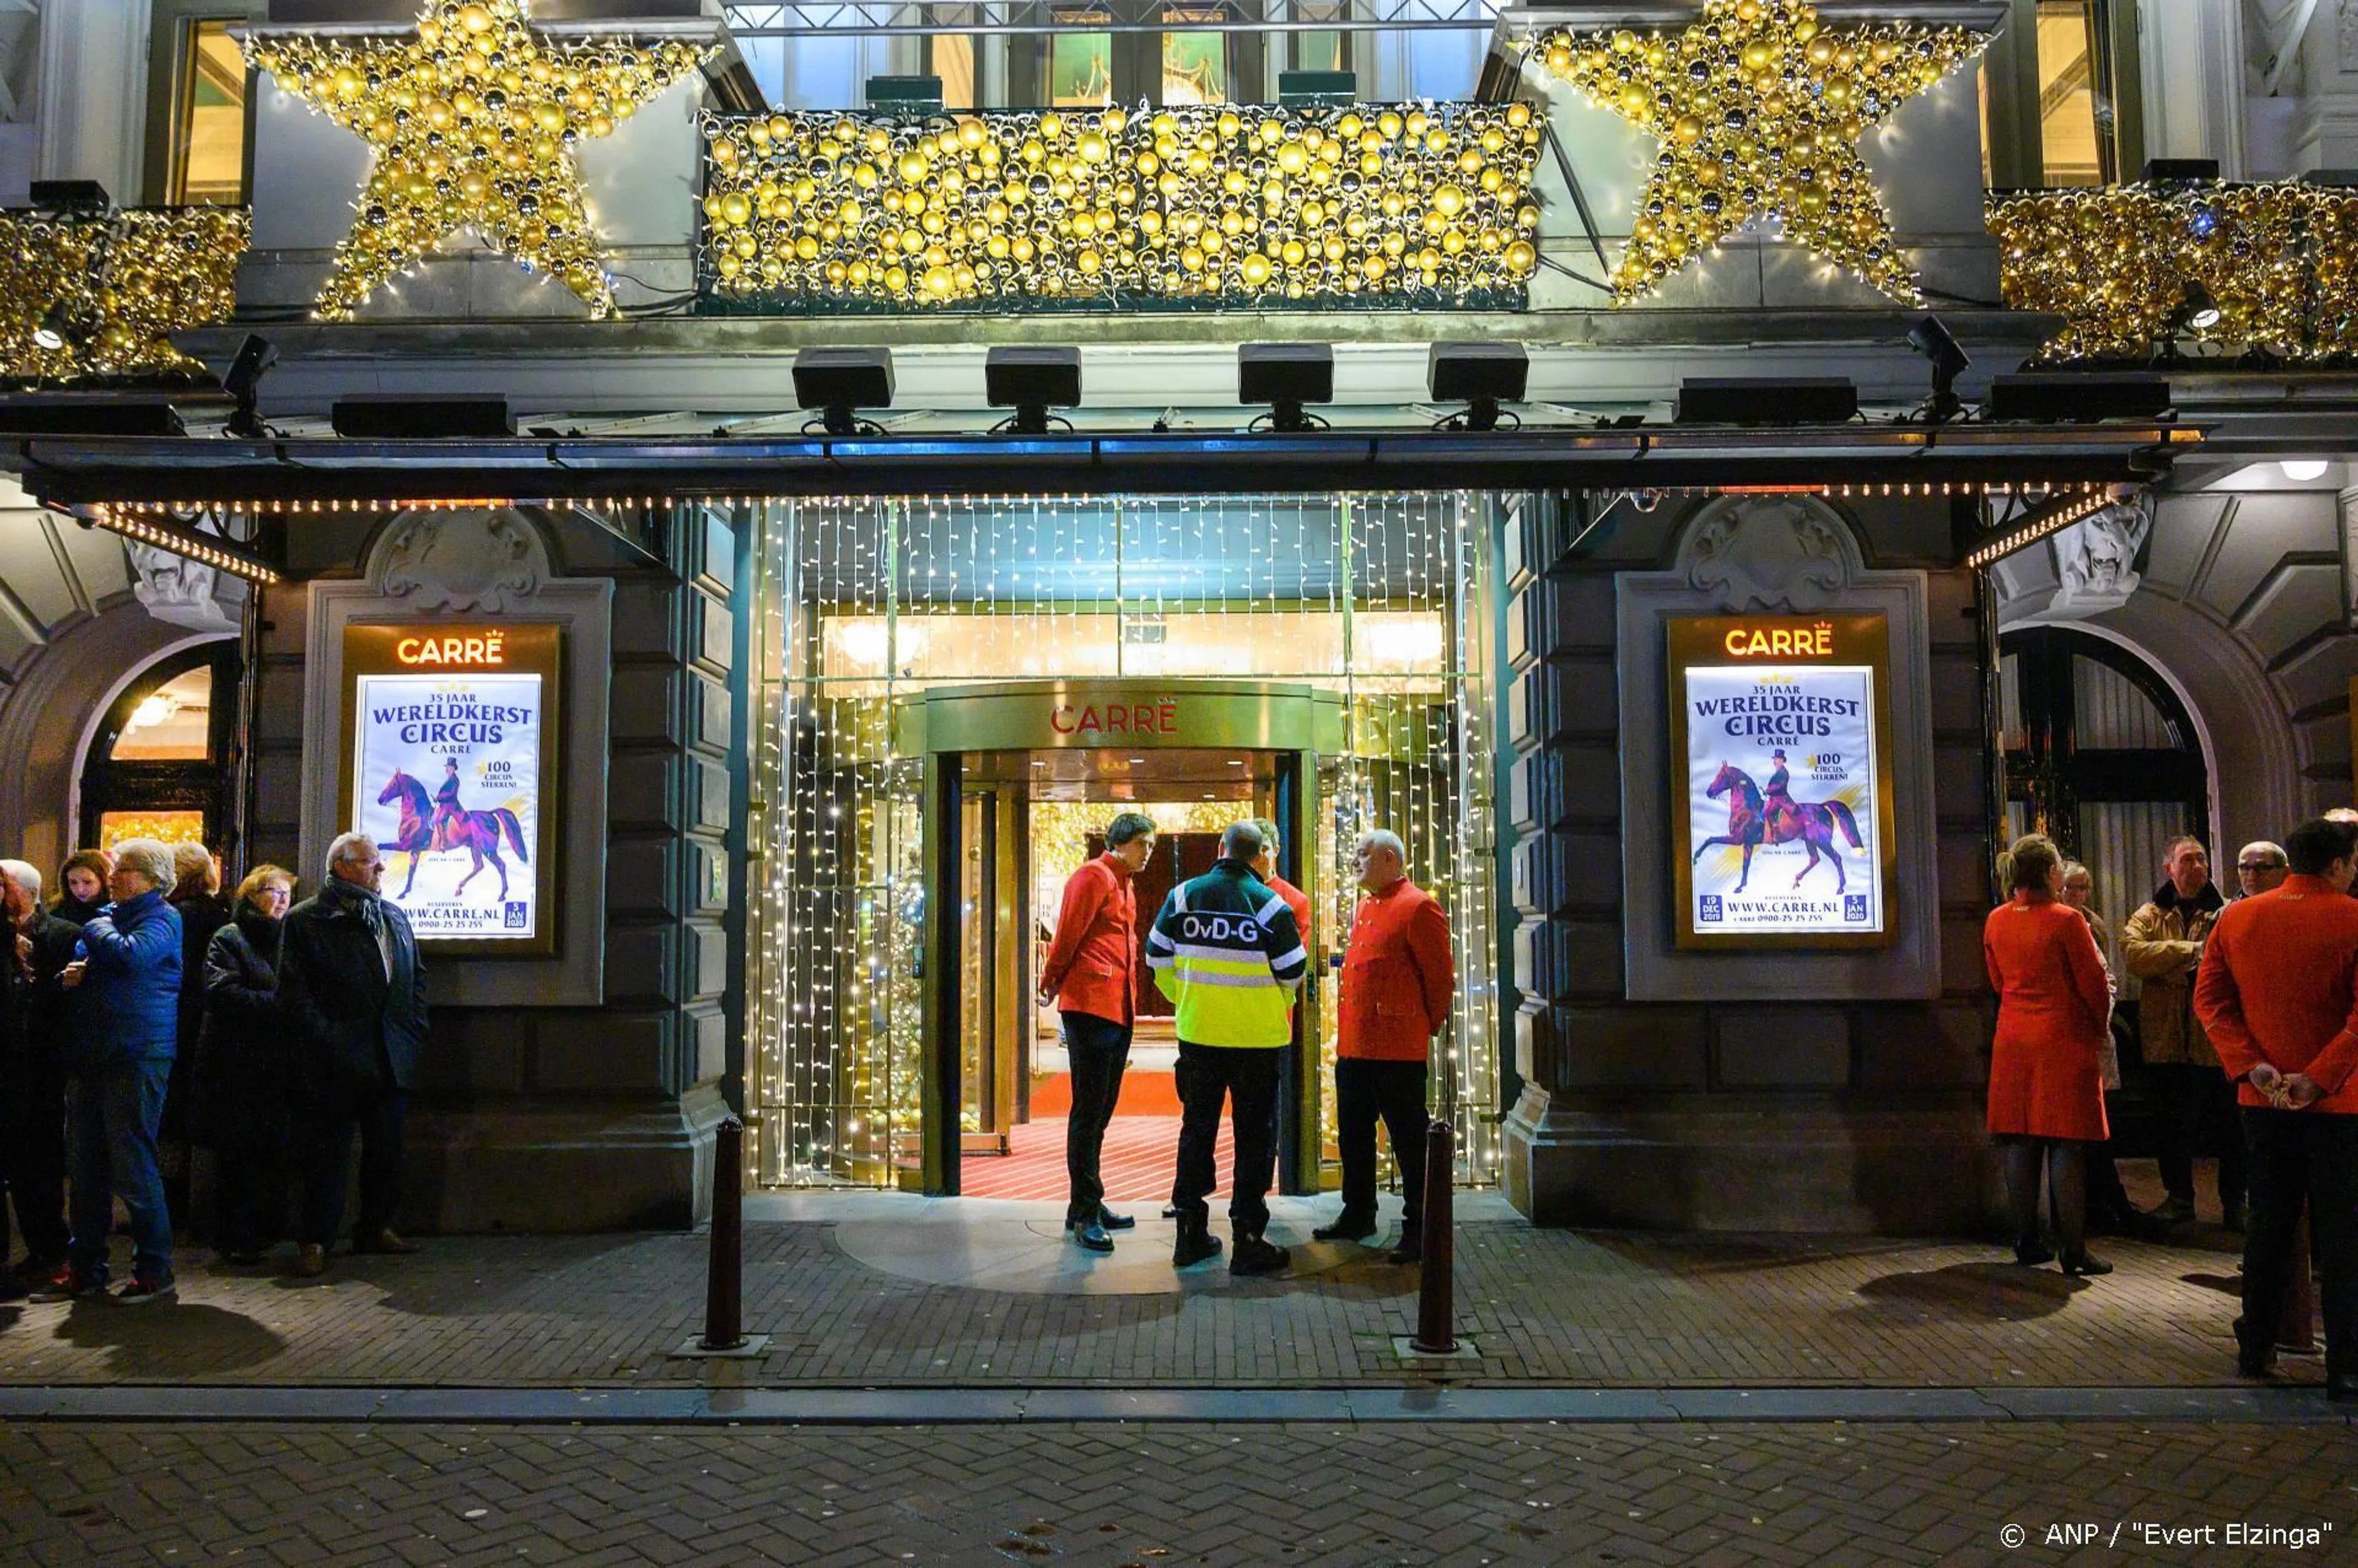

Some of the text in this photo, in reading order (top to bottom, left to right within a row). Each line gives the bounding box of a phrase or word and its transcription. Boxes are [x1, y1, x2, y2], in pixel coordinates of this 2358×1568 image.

[1753, 685, 1800, 696] 35 JAAR
[430, 694, 476, 703] 35 JAAR
[1695, 696, 1859, 717] WERELDKERST
[373, 704, 532, 724] WERELDKERST
[1724, 715, 1831, 736] CIRCUS
[400, 723, 502, 743] CIRCUS
[1816, 753, 1841, 765] 100
[488, 761, 511, 772] 100
[1706, 896, 1717, 905] 19
[1851, 895, 1858, 904] 5
[513, 902, 519, 911] 5
[507, 911, 524, 920] JAN
[1183, 916, 1258, 943] OvD-G
